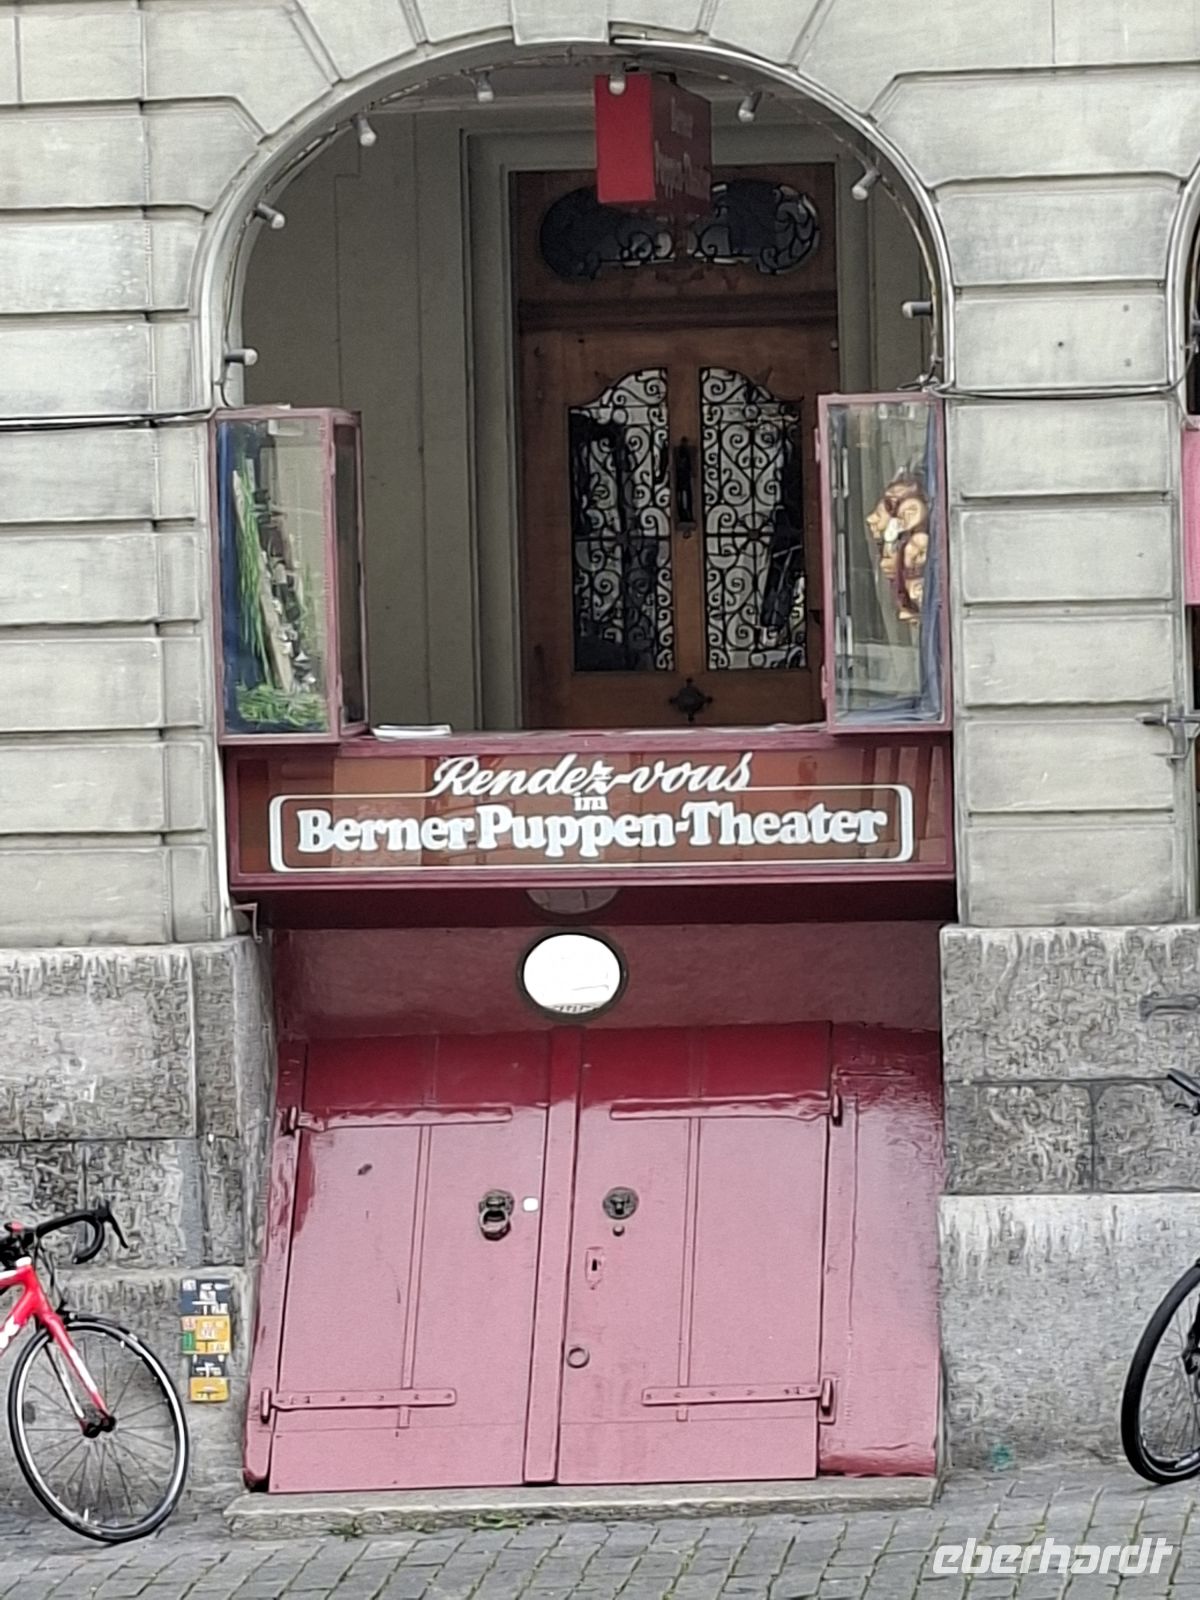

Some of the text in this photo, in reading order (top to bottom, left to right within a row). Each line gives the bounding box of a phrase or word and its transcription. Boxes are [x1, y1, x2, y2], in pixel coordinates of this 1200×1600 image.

[432, 752, 753, 796] Rendez-vous
[573, 791, 608, 811] im
[297, 801, 888, 857] Berner Puppen-Theater
